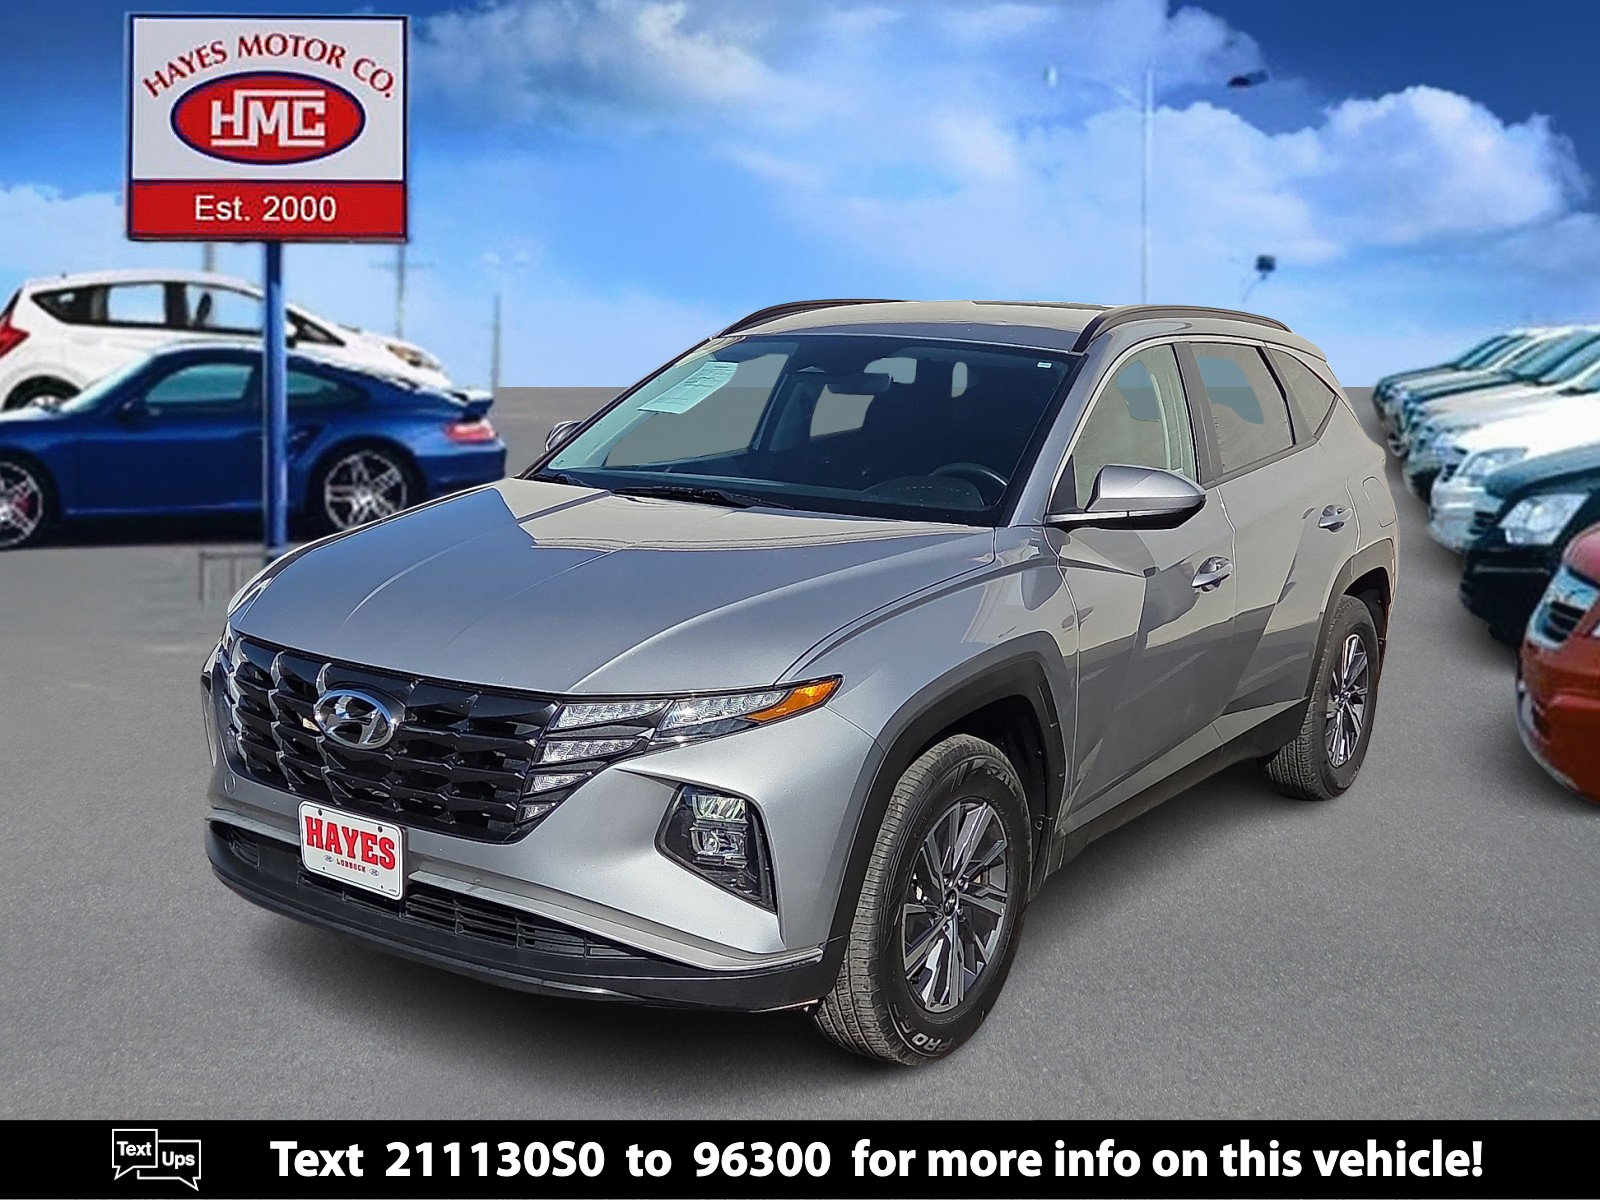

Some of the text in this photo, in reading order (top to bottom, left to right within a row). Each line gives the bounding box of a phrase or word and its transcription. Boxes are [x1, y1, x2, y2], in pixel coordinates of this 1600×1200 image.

[142, 33, 395, 98] HAYES MOTOR CO.
[210, 88, 326, 147] HMC
[194, 194, 338, 222] Est. 2000
[305, 815, 396, 870] HAYES
[336, 858, 366, 873] LUBBOCK
